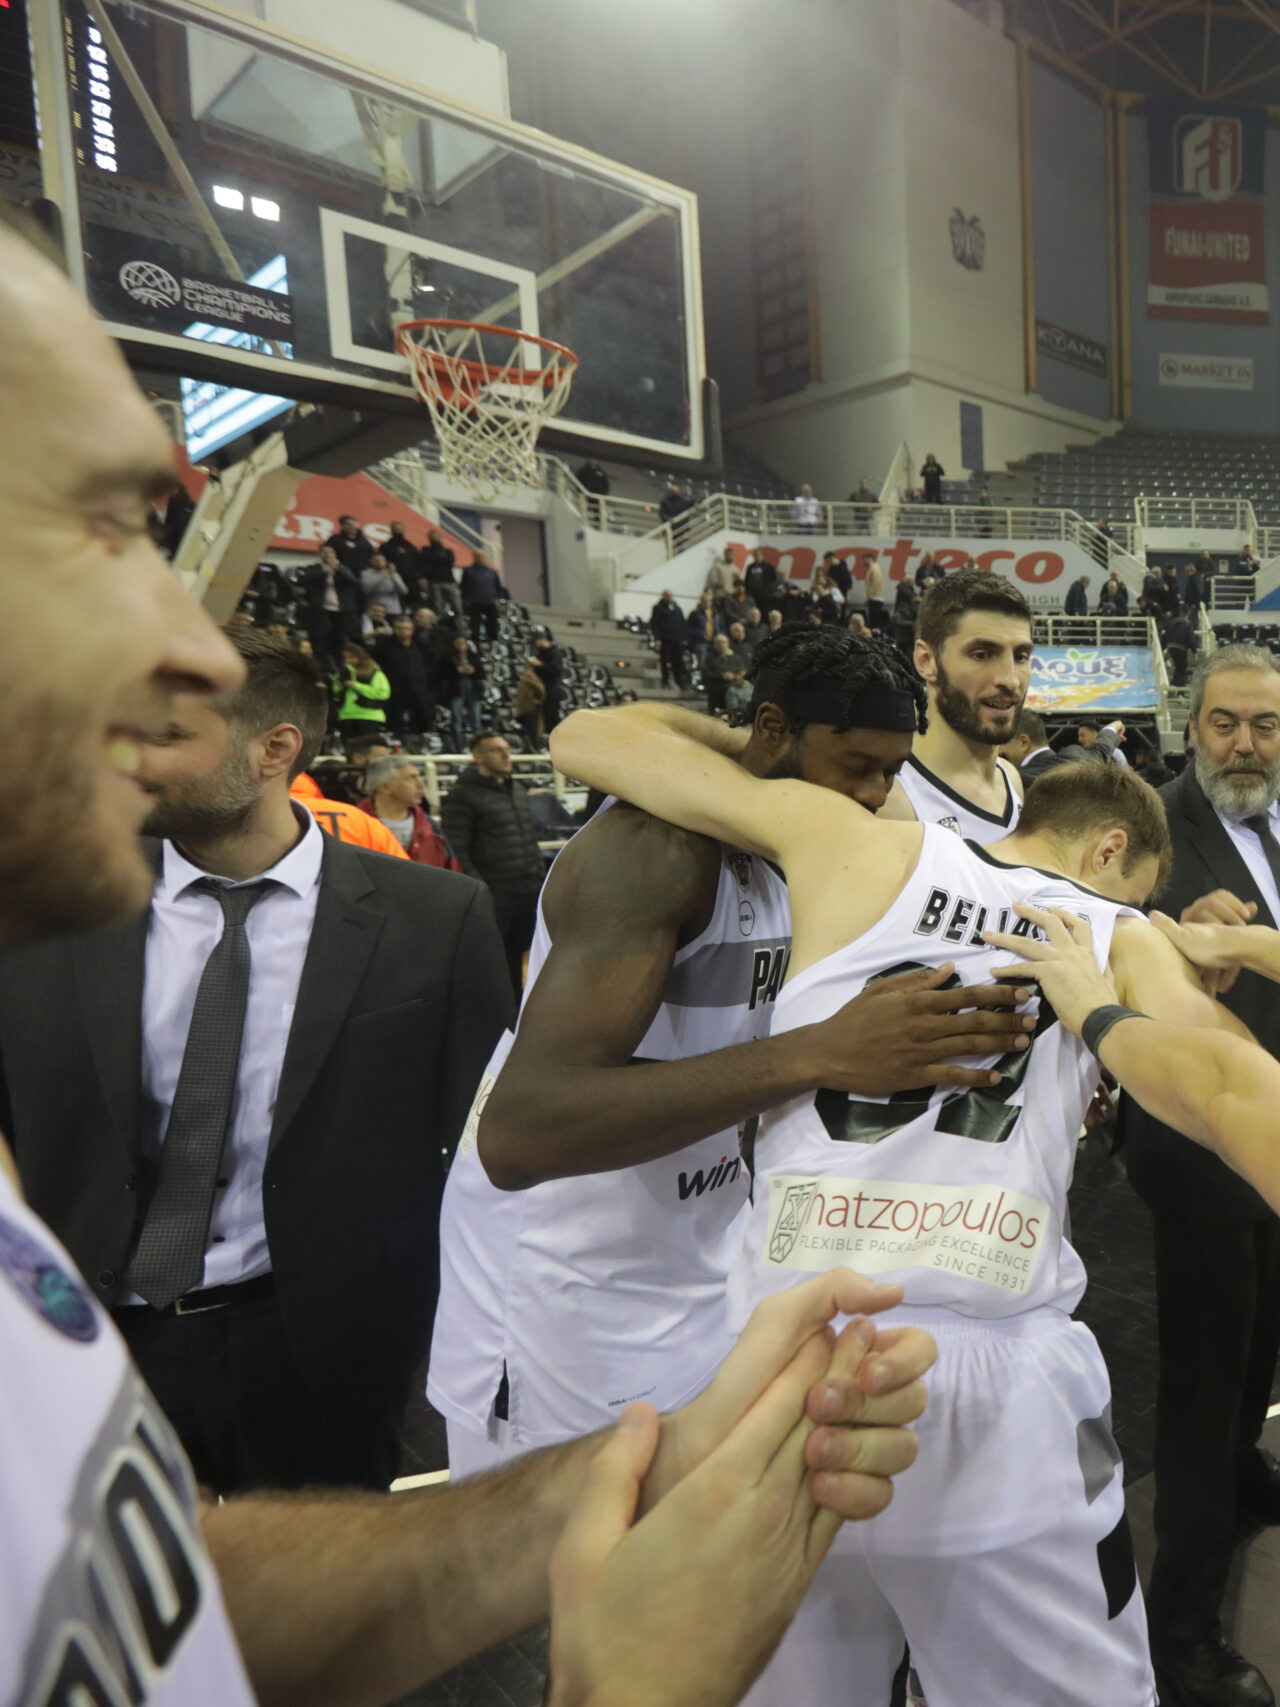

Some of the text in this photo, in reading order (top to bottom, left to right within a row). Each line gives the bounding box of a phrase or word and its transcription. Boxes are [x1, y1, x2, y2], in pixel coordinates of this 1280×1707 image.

[182, 277, 279, 311] BASKETBALL
[183, 288, 291, 324] CHAMPIONS
[184, 301, 245, 323] LEAGUE
[678, 1155, 742, 1201] win
[799, 1234, 1030, 1273] FLEXIBLE PACKAGING EXCELLENCE
[933, 1253, 1027, 1292] SINCE 1931
